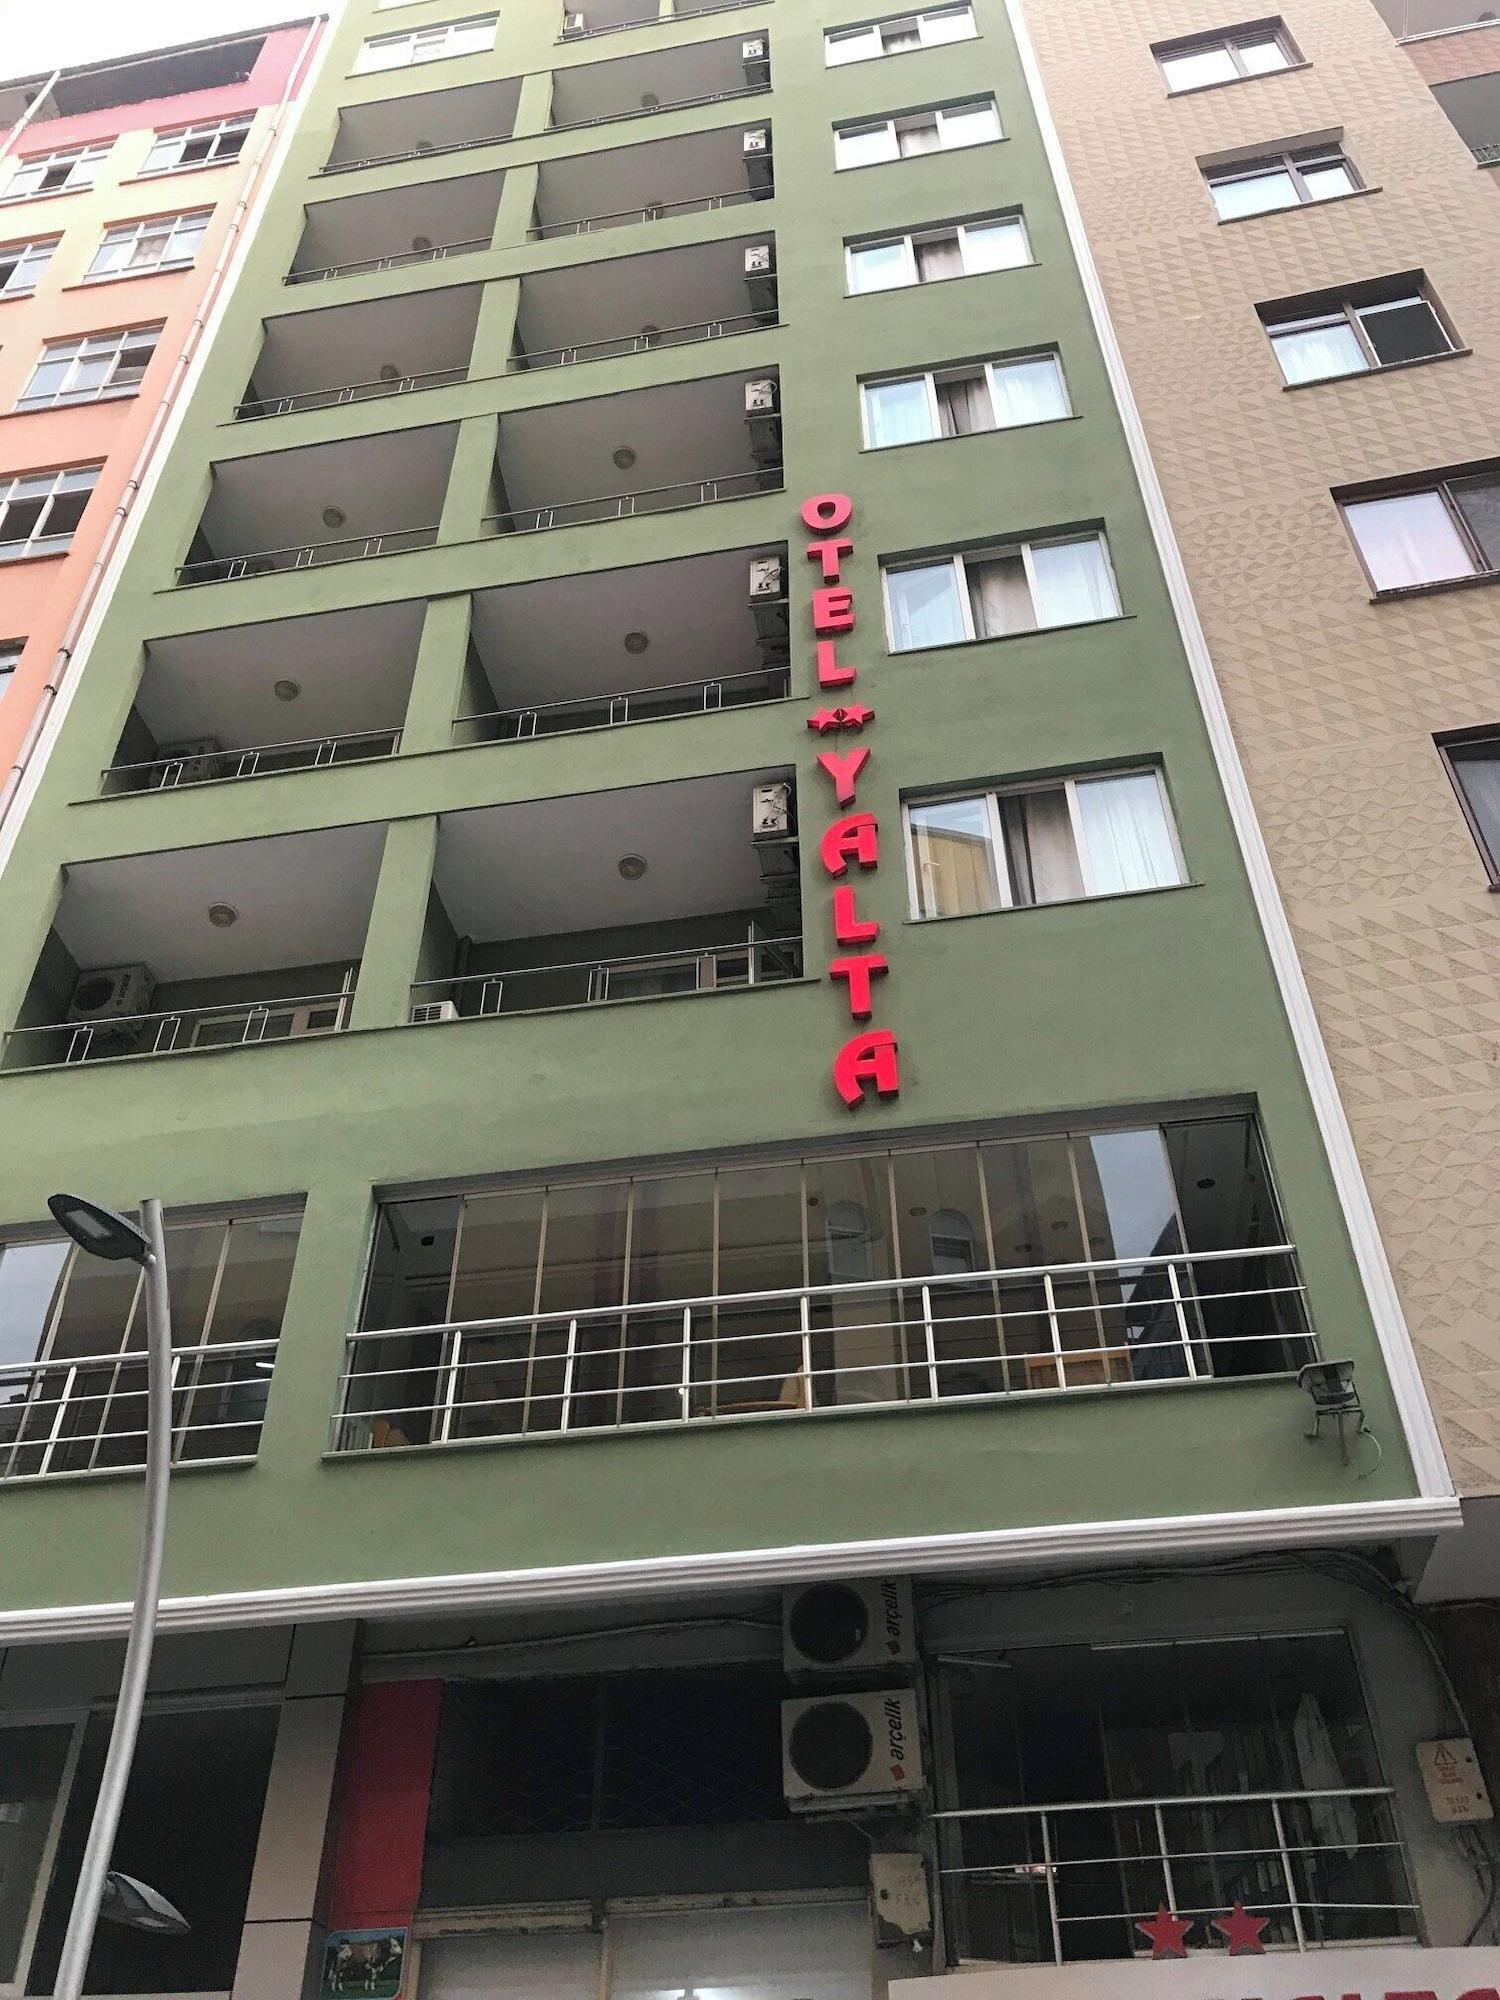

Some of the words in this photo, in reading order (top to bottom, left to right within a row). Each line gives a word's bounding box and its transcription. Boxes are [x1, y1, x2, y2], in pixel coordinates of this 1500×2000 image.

[801, 494, 857, 689] OTEL
[816, 747, 900, 1110] YALTA
[881, 1579, 902, 1636] arçelik
[884, 1698, 907, 1761] arçelik
